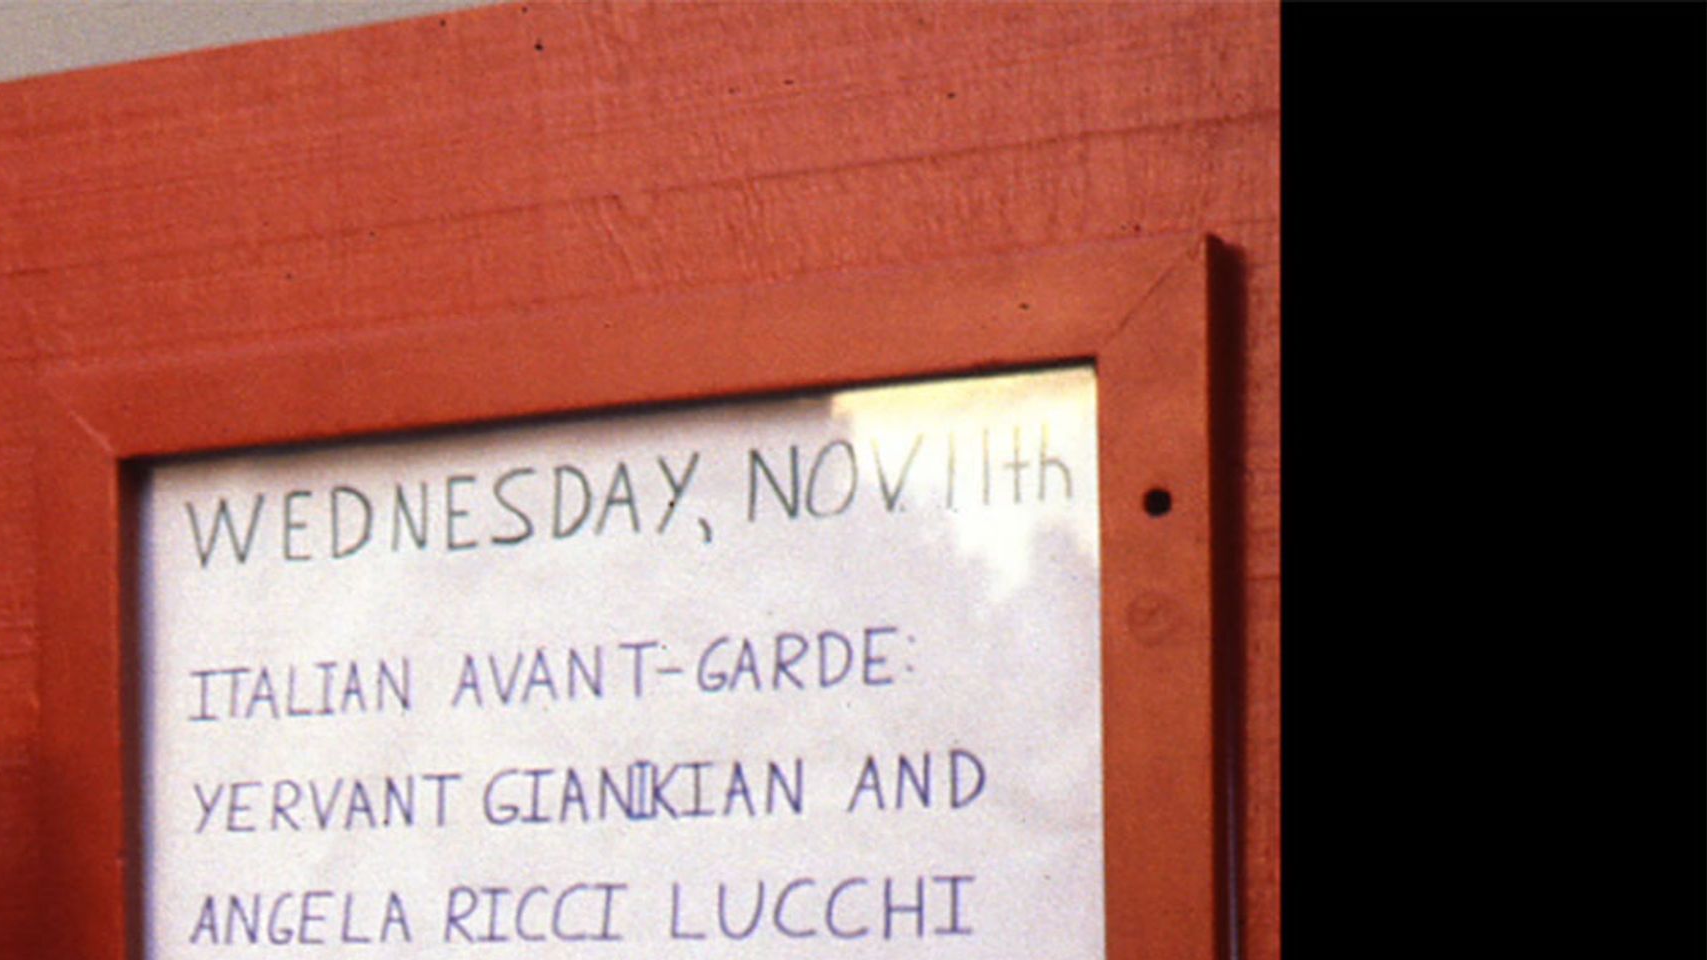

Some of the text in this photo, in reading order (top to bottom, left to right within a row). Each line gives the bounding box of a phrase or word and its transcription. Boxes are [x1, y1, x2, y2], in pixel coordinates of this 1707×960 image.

[186, 451, 714, 568] WEDNESDAY,
[943, 422, 1072, 508] 11th
[187, 627, 916, 722] ITALIAN AVANT-GARDE:
[194, 773, 462, 833] YERVANT
[848, 749, 986, 813] AND
[189, 874, 975, 946] ANGELA RICCI LUCCHI
